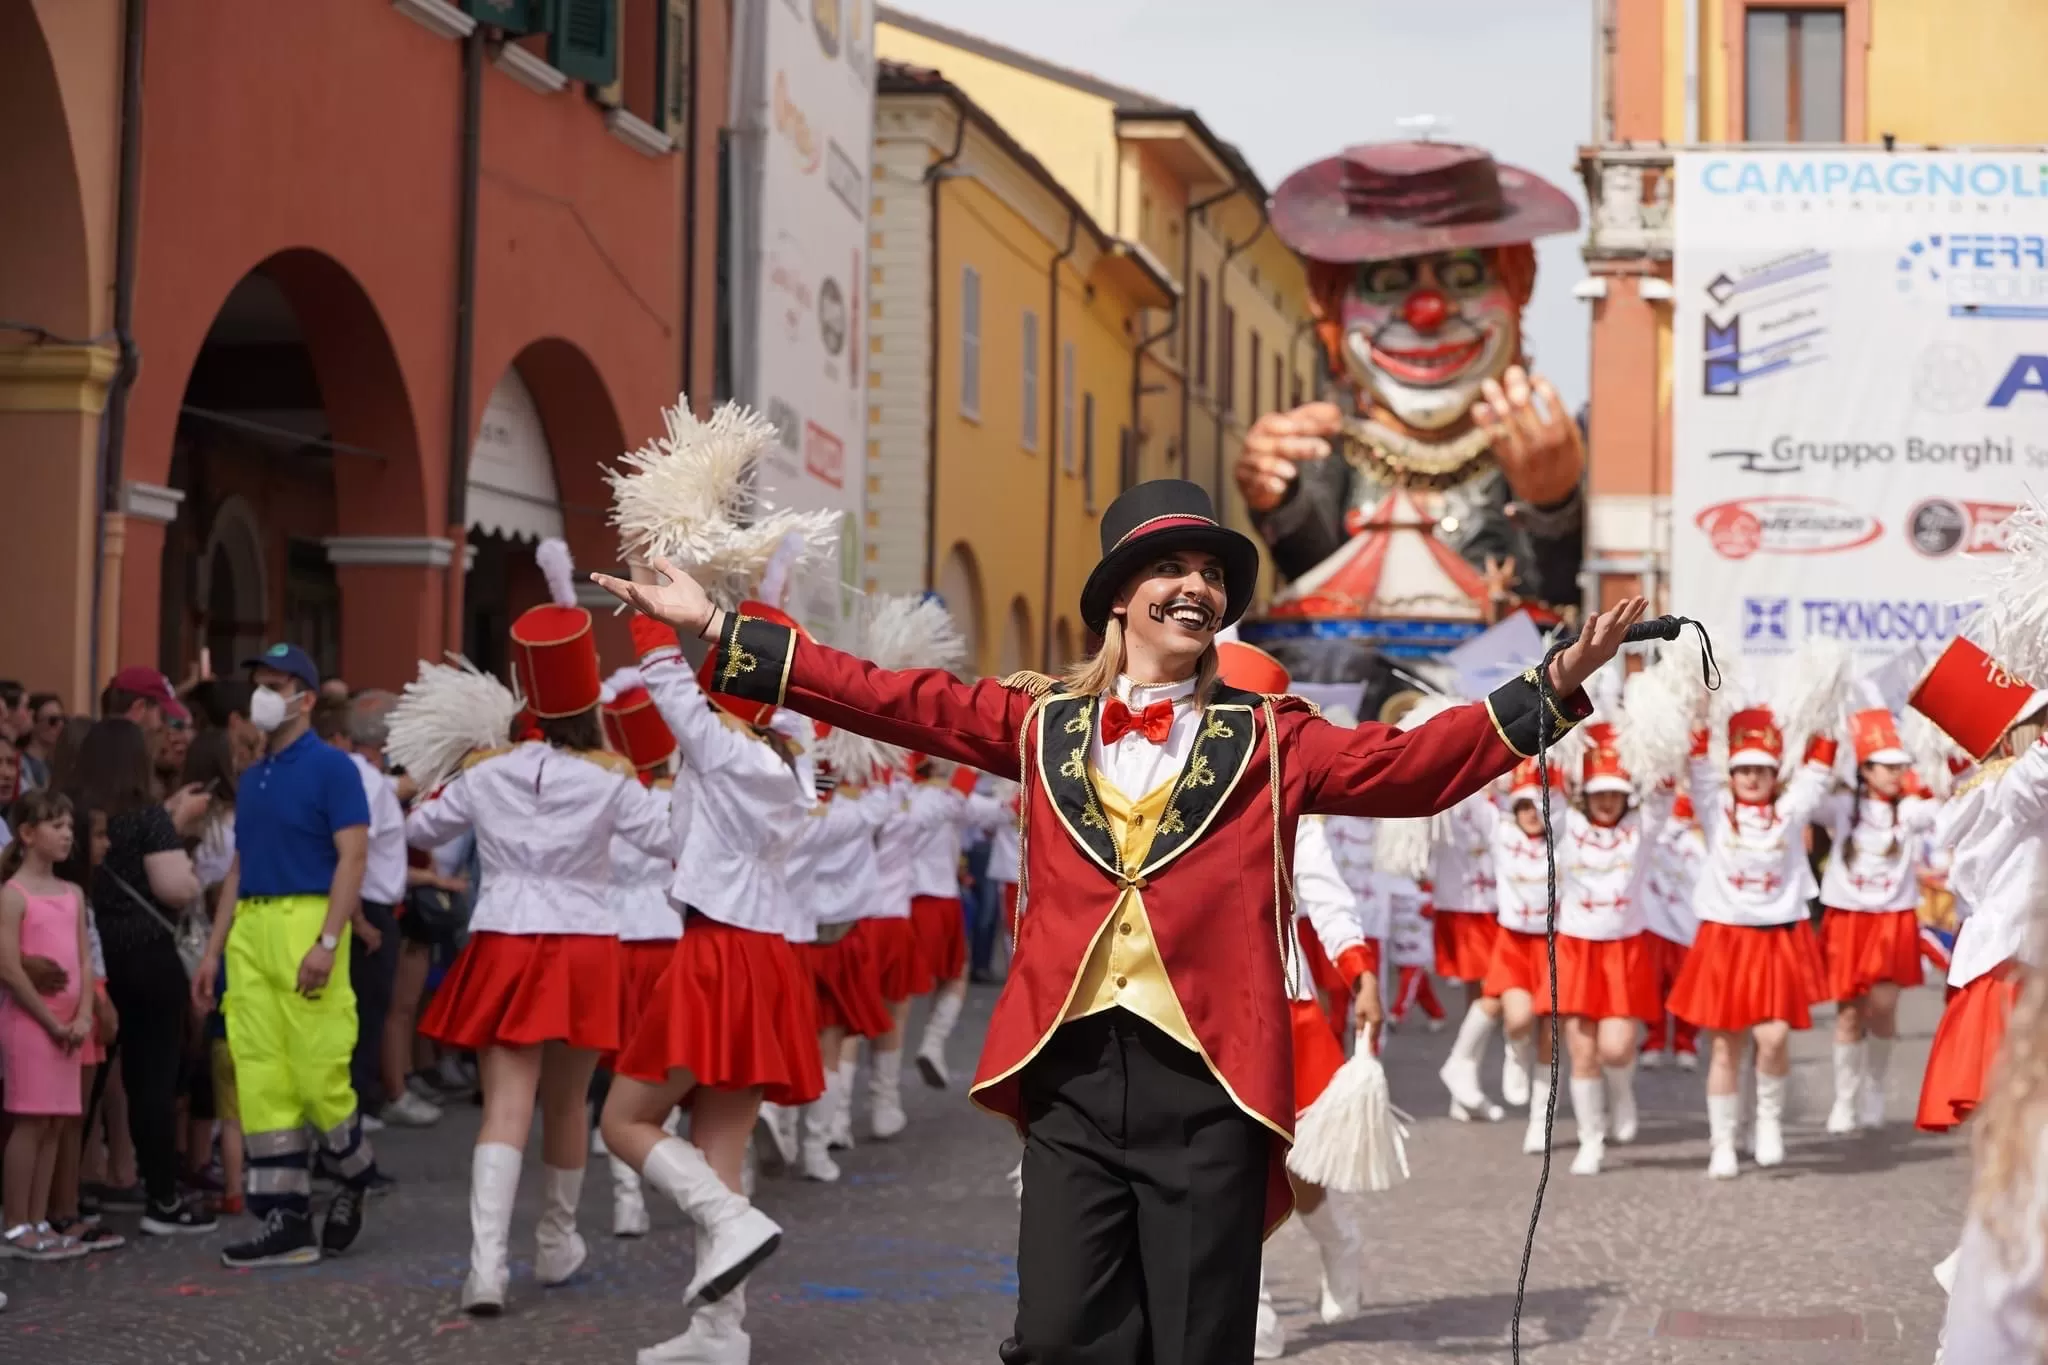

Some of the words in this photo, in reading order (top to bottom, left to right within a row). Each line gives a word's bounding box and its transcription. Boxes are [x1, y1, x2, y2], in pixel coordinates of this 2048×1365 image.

[1771, 435, 1896, 468] Gruppo
[1905, 436, 2013, 472] Borghi
[1802, 600, 1984, 641] TEKNOSOU
